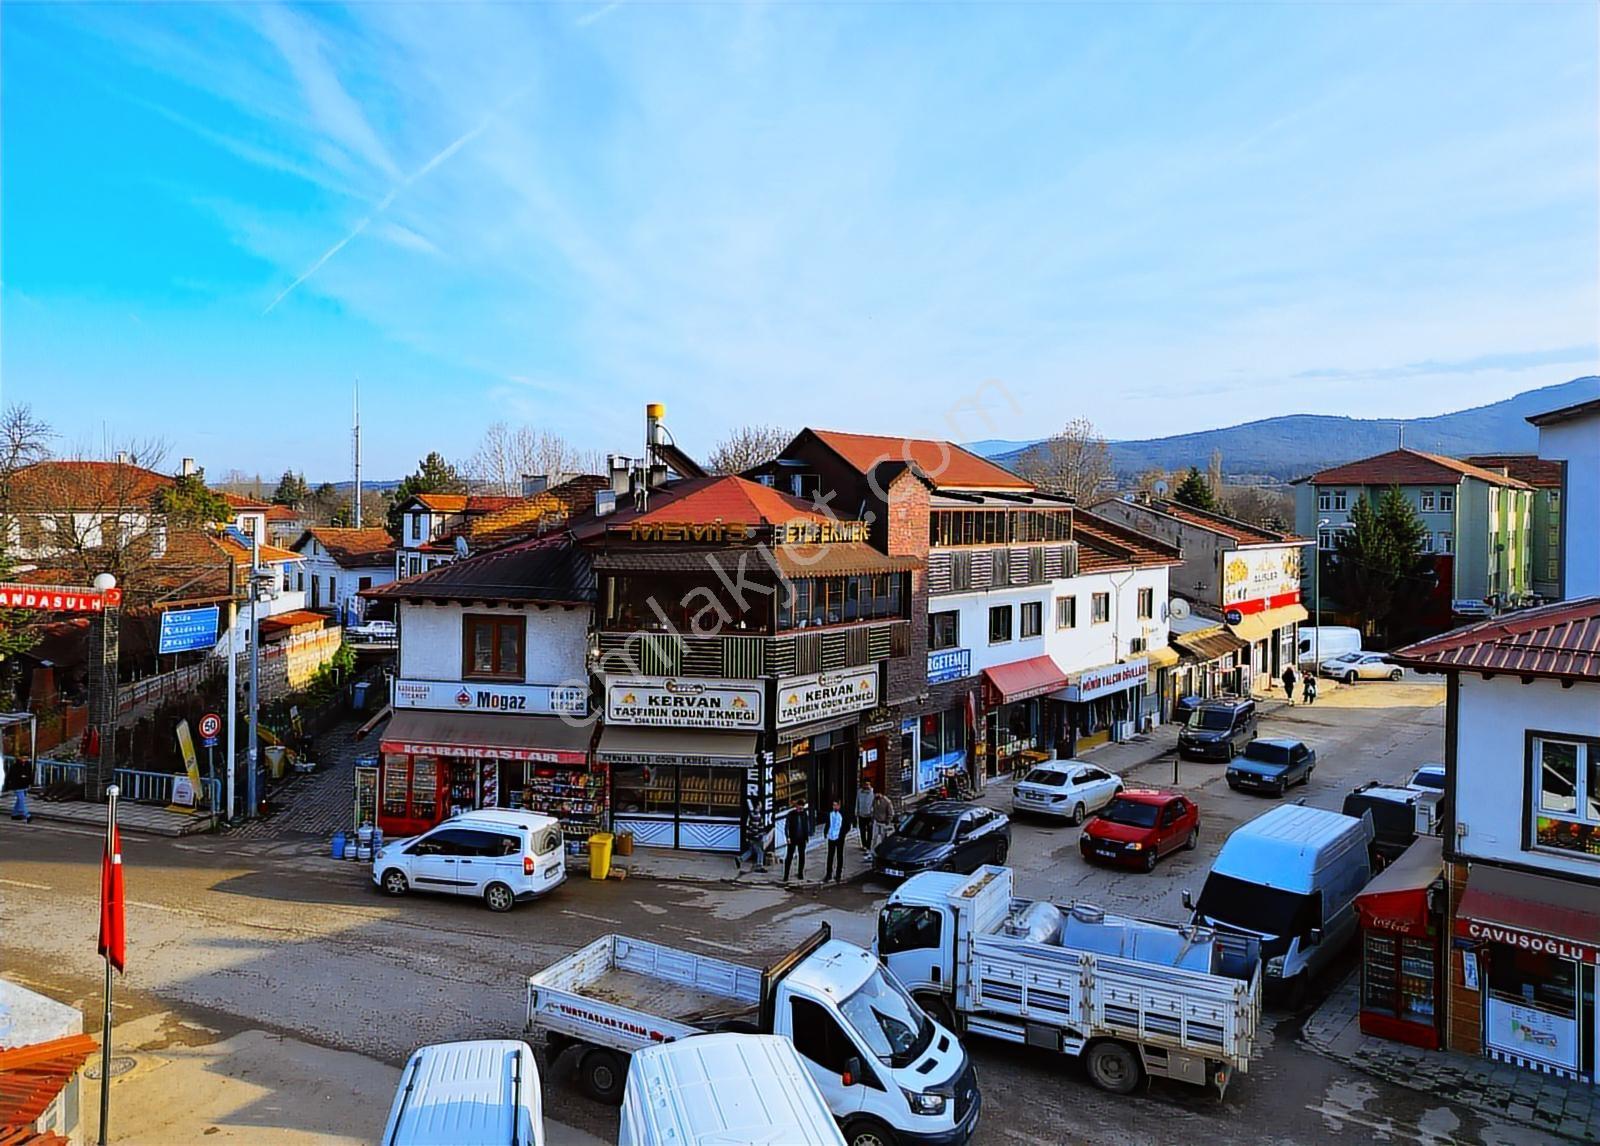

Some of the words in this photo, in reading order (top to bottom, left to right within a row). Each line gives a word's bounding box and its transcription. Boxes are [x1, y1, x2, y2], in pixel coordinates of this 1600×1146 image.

[477, 691, 526, 710] Mogaz
[805, 684, 853, 702] KERVAN
[648, 695, 720, 708] KERVAN
[672, 709, 705, 718] ODUN
[1469, 924, 1583, 960] ÇAVUŞOĞLU
[617, 1022, 647, 1036] TARIM
